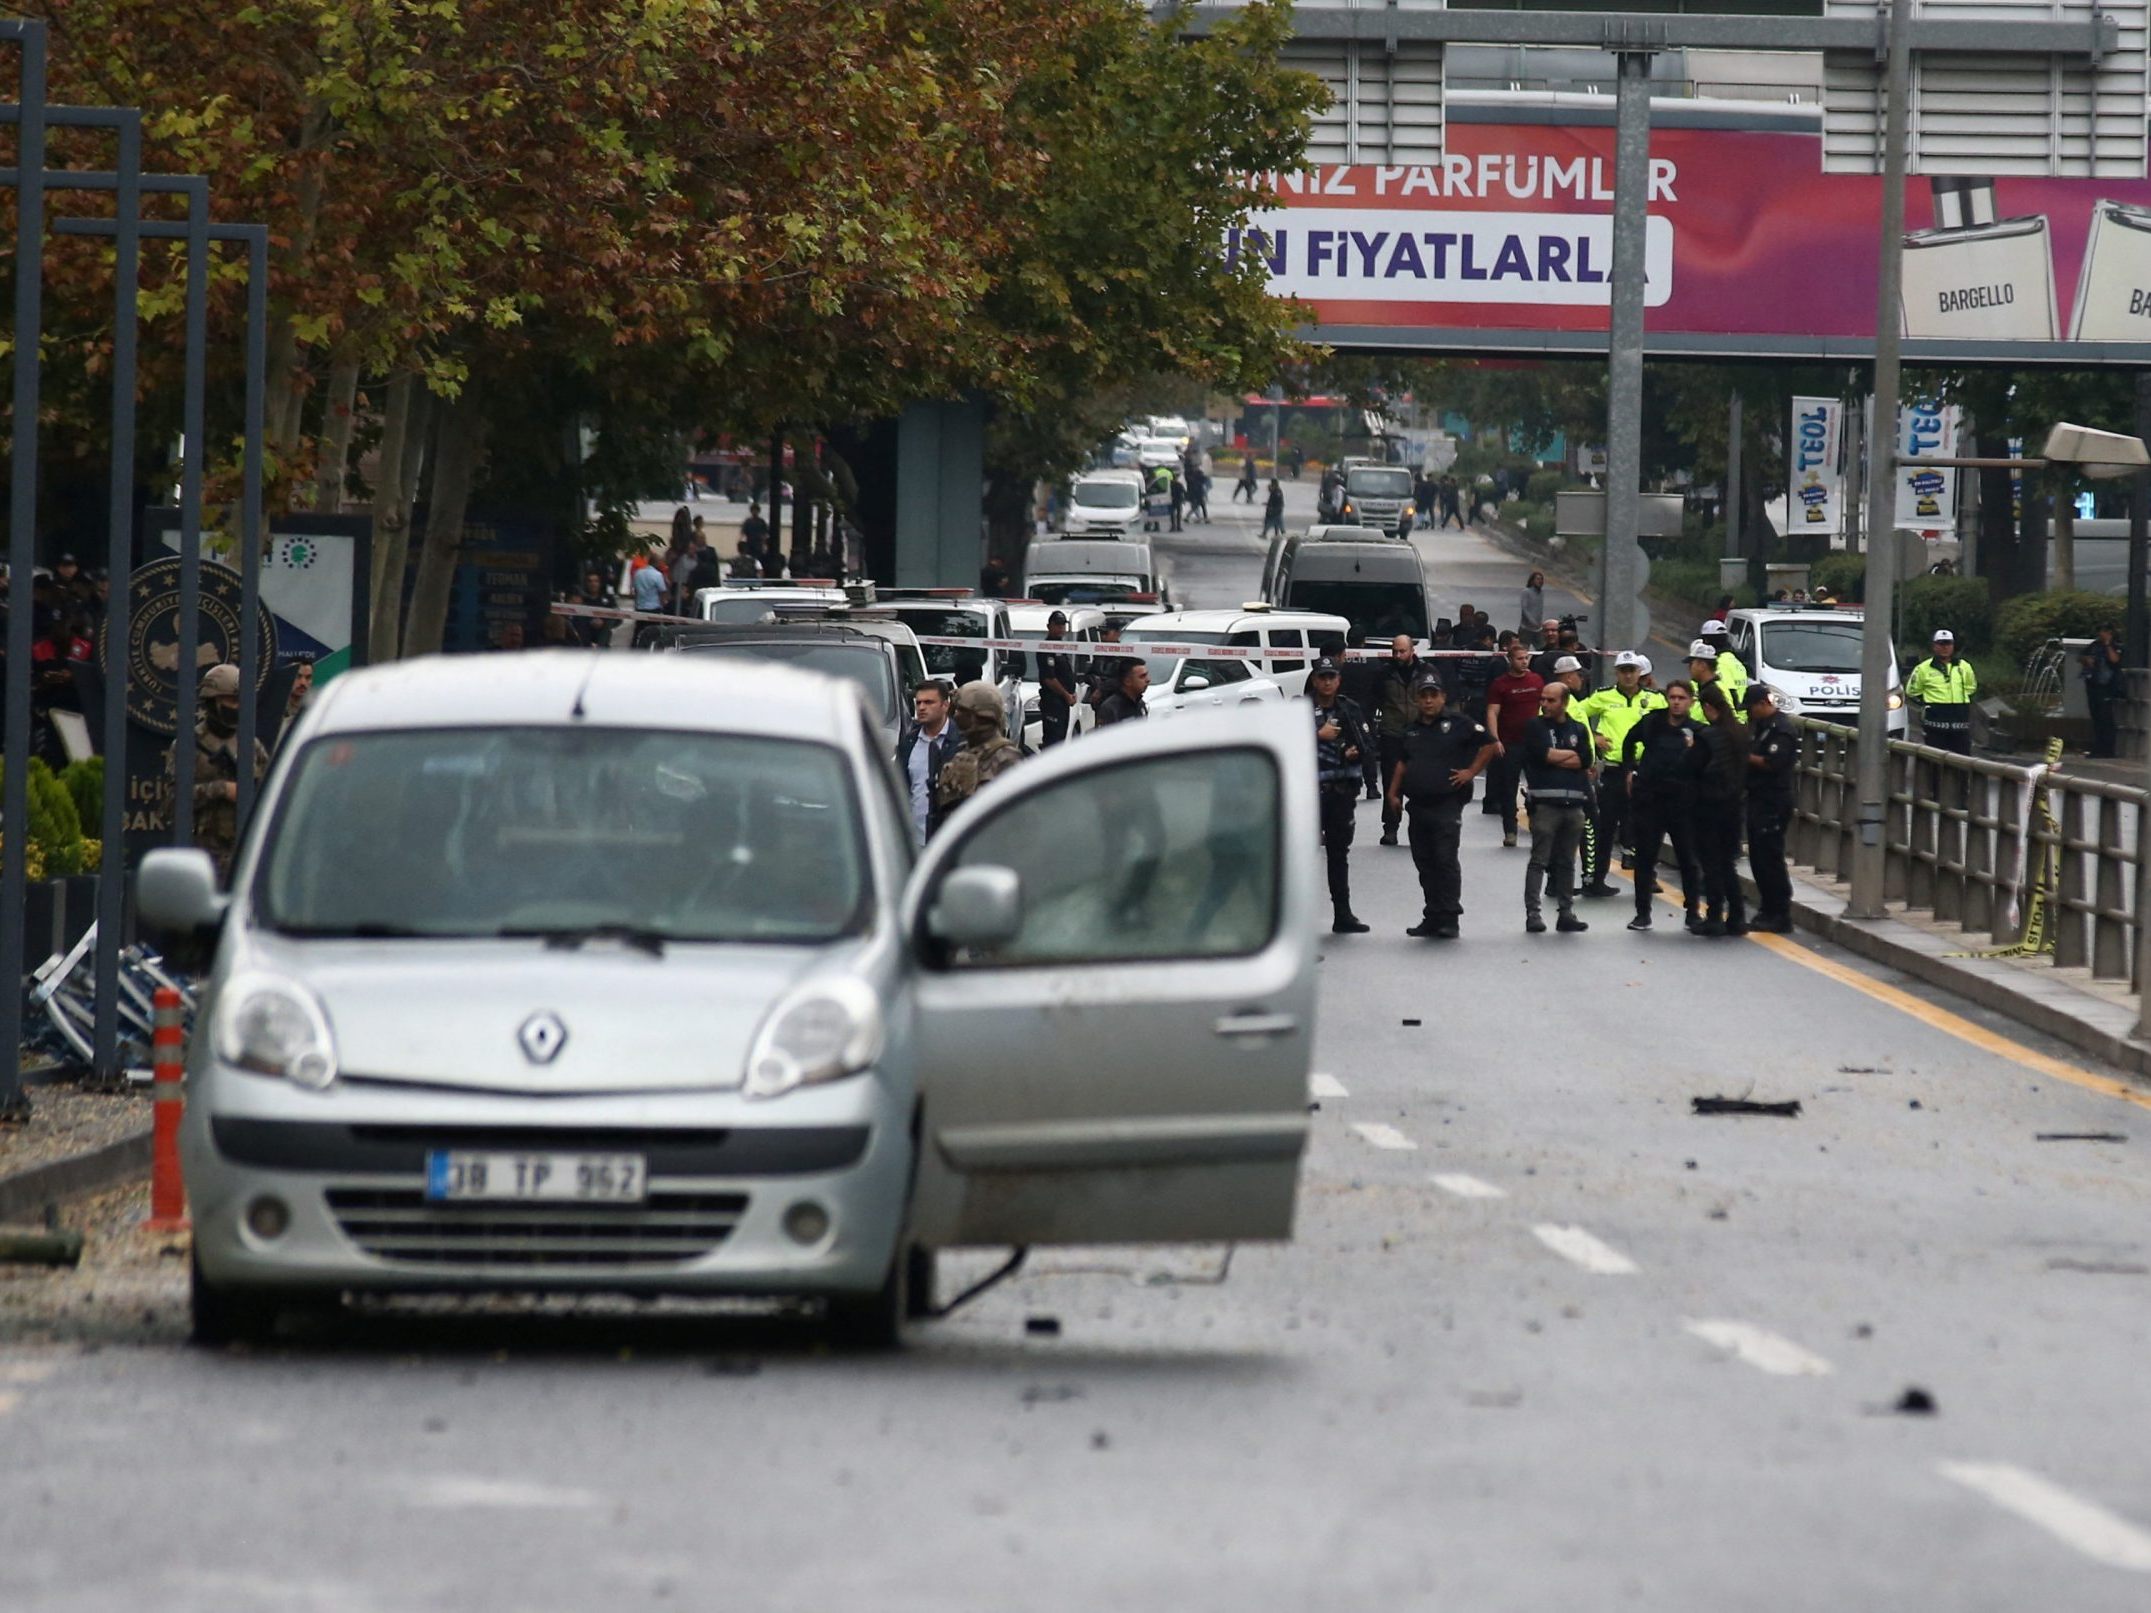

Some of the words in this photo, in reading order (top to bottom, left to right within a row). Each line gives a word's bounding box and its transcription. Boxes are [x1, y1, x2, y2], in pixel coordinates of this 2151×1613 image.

[1376, 154, 1677, 201] PARFÜMLR
[1308, 231, 1649, 283] FİYATLARL
[1938, 283, 2014, 313] BARGELLO
[1809, 685, 1861, 696] POLİS
